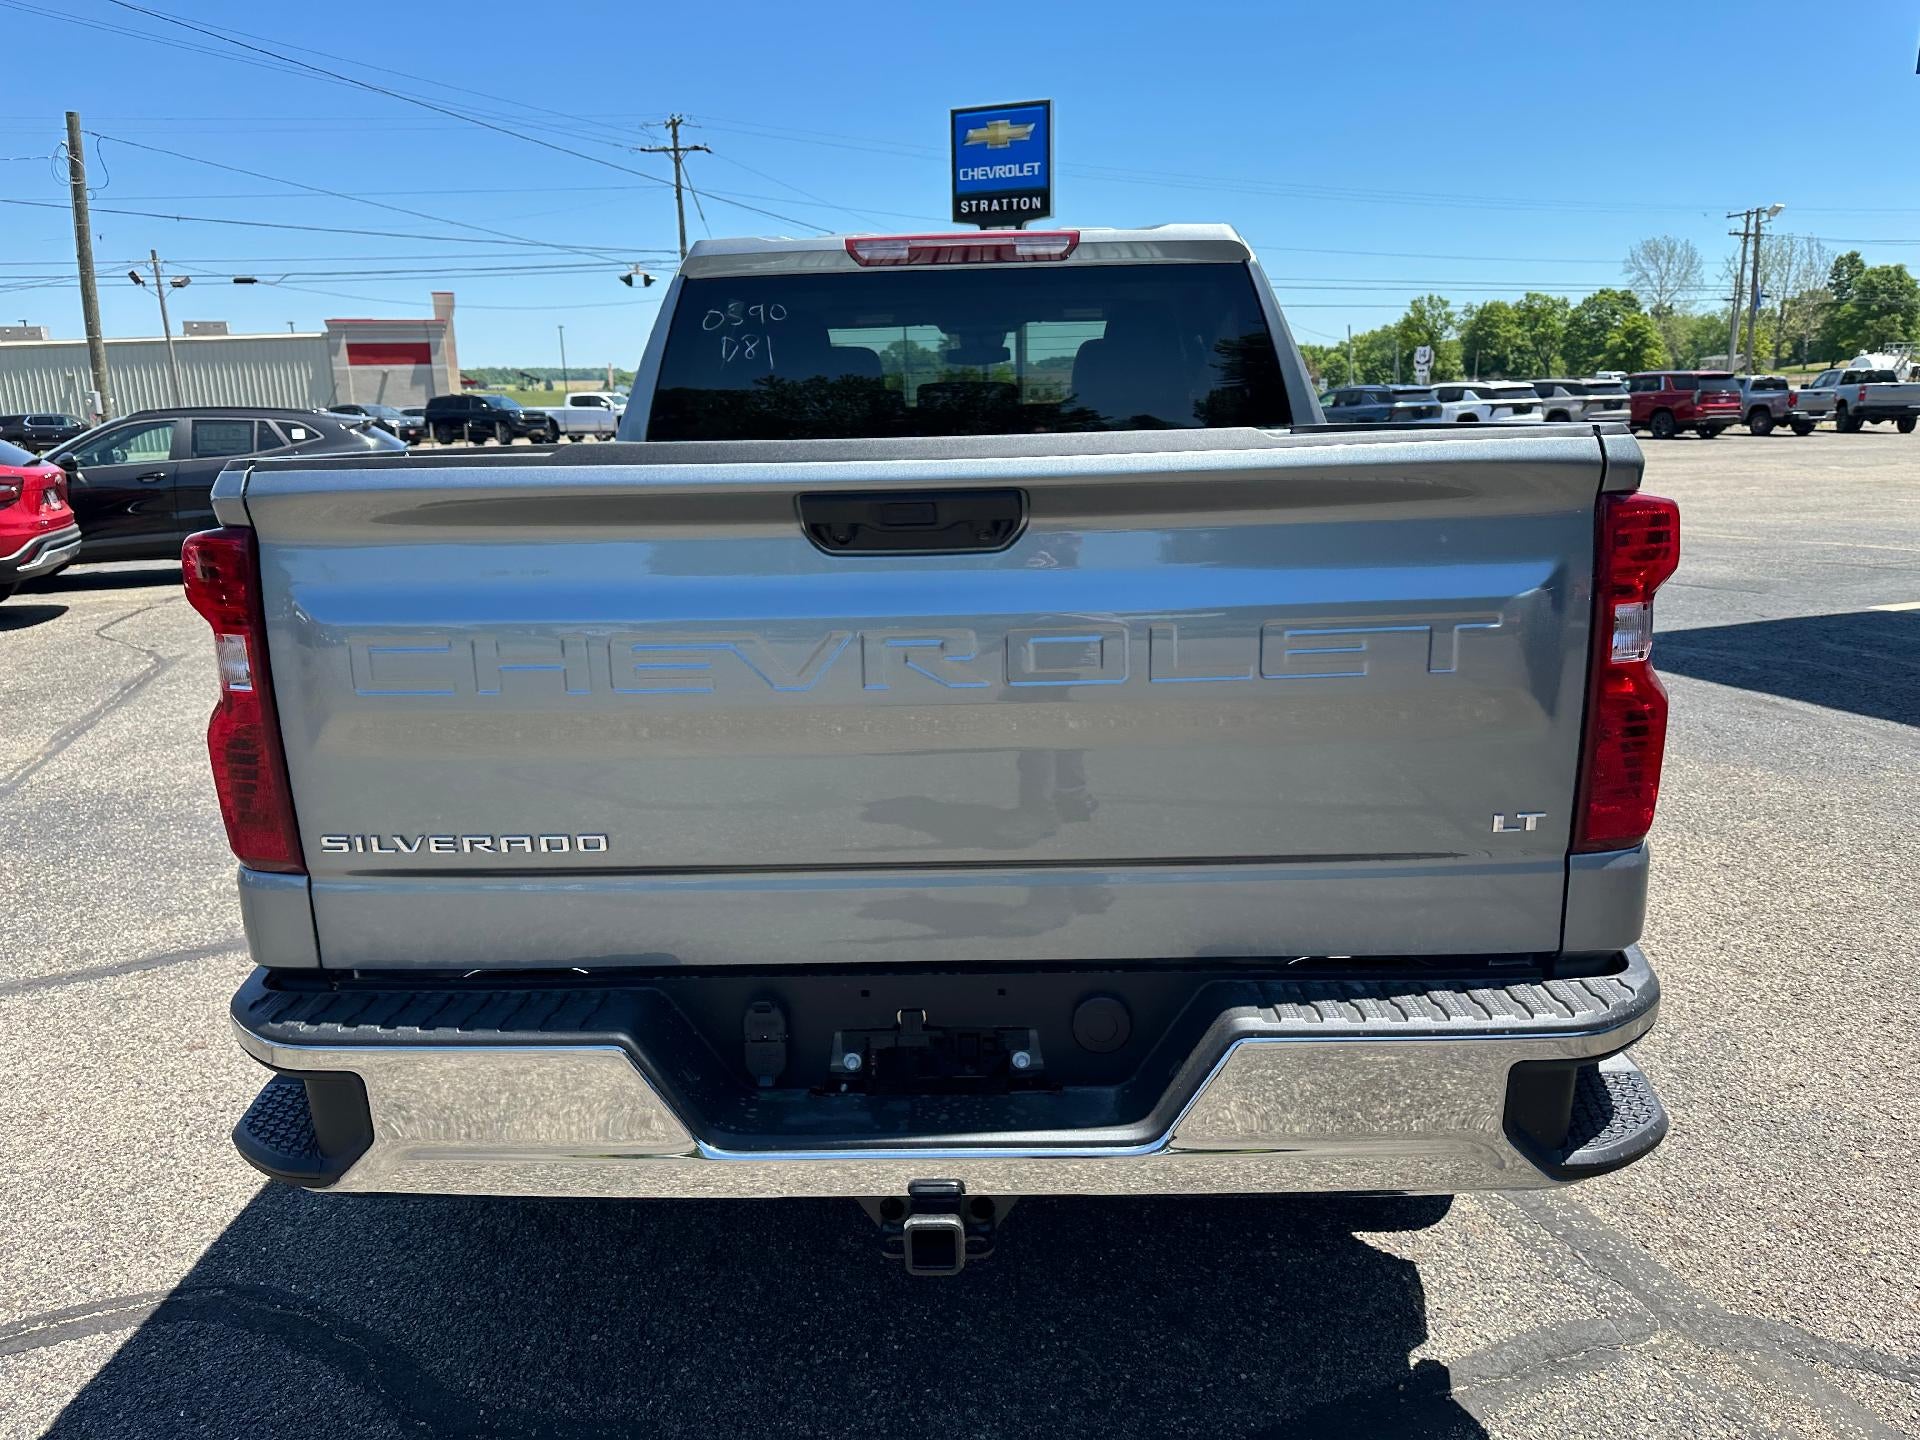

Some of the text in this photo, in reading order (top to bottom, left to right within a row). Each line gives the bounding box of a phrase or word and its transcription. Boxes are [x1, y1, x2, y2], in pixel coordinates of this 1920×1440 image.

[960, 162, 1041, 181] CHEVROLET
[960, 196, 1041, 213] STRATTON
[348, 612, 1503, 696] CHEVROLET
[1492, 812, 1547, 833] LT
[320, 834, 609, 853] SILVERADO
